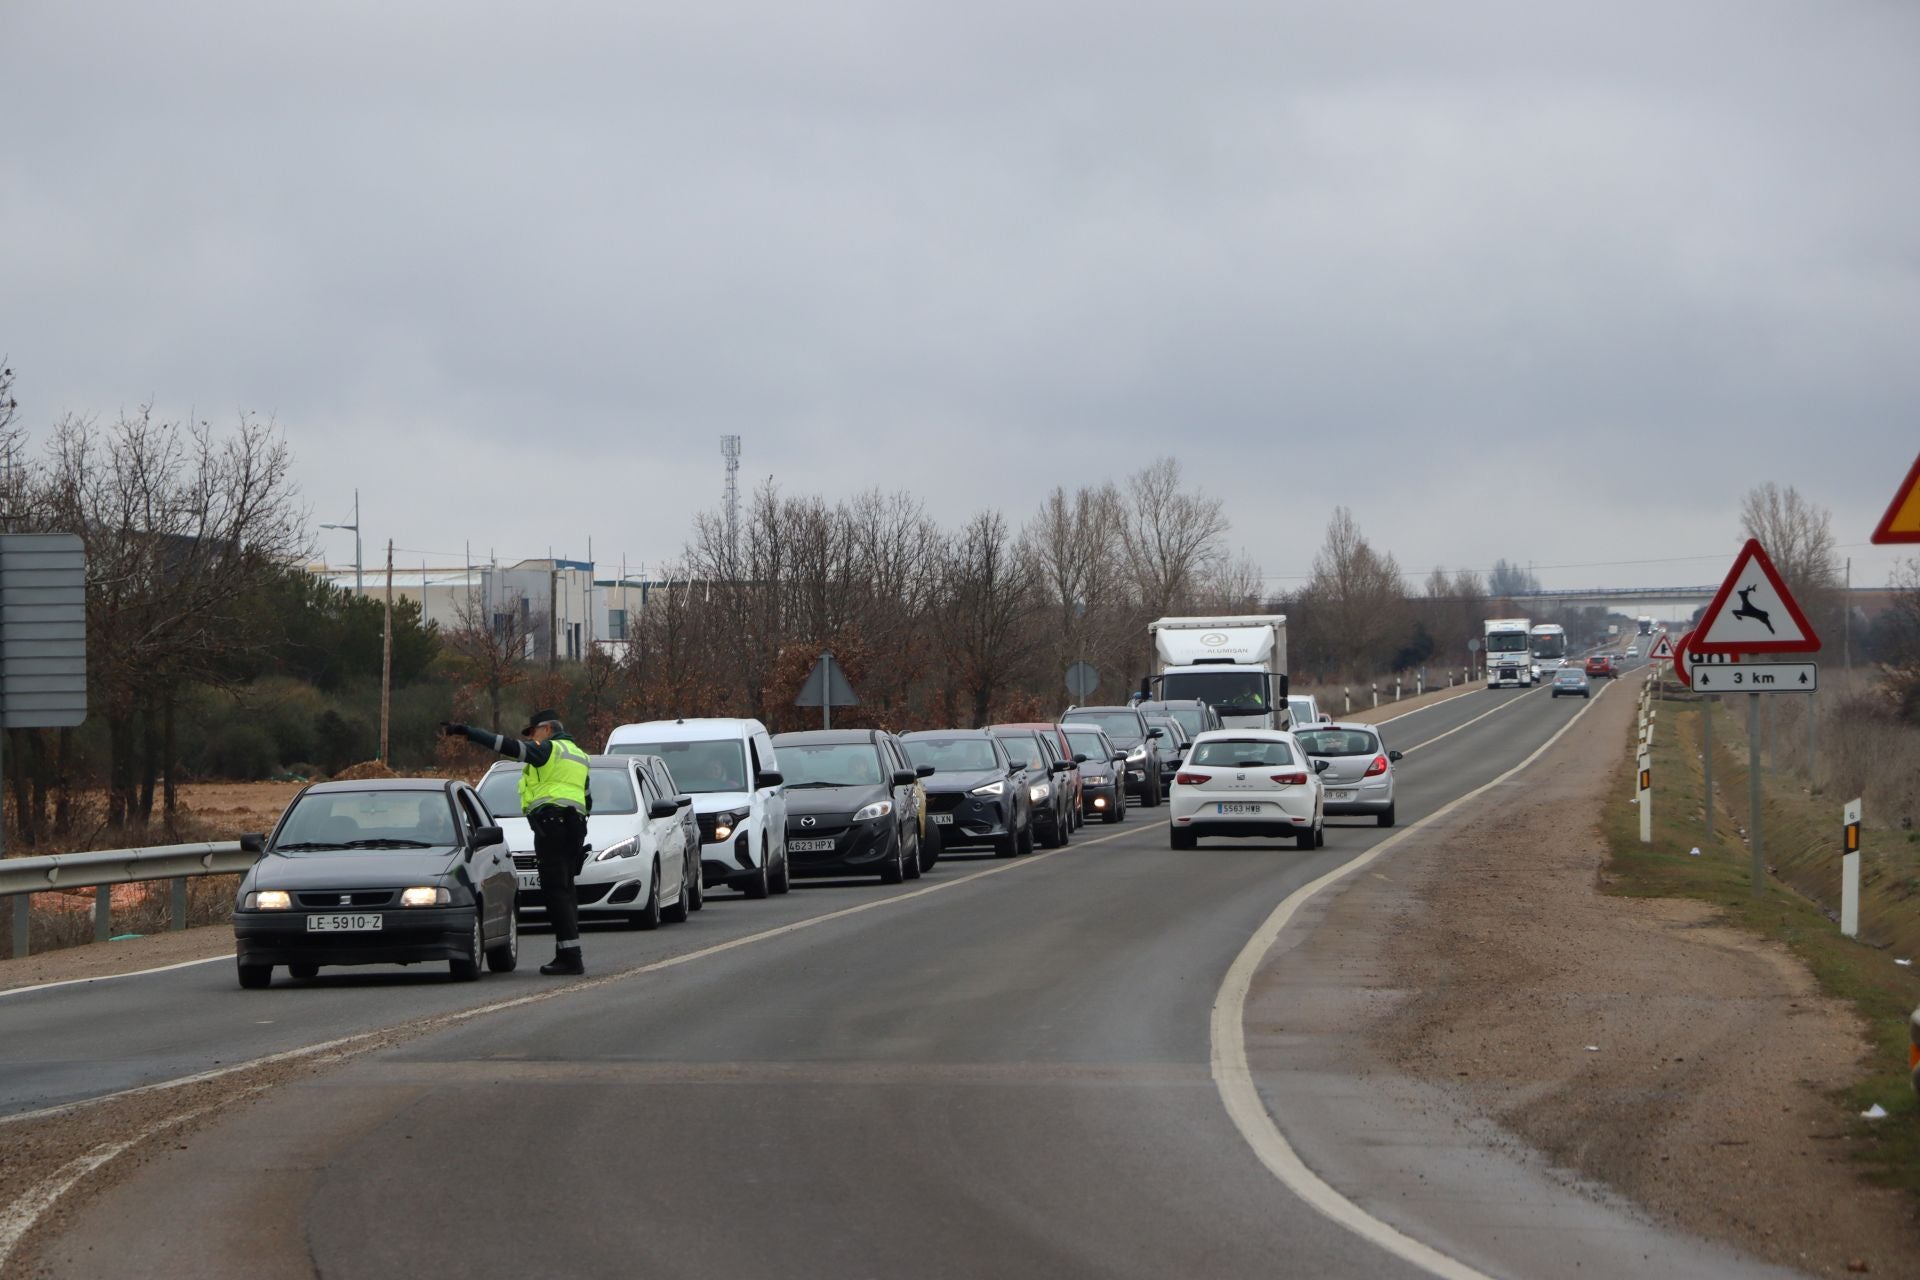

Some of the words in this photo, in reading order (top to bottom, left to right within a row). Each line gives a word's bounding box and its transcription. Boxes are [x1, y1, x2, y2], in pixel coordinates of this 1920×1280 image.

[1733, 672, 1743, 684] 3
[1752, 672, 1775, 684] km
[1223, 804, 1244, 813] 5563
[1849, 811, 1855, 820] 6
[789, 841, 813, 851] 4623
[815, 840, 832, 850] HPX
